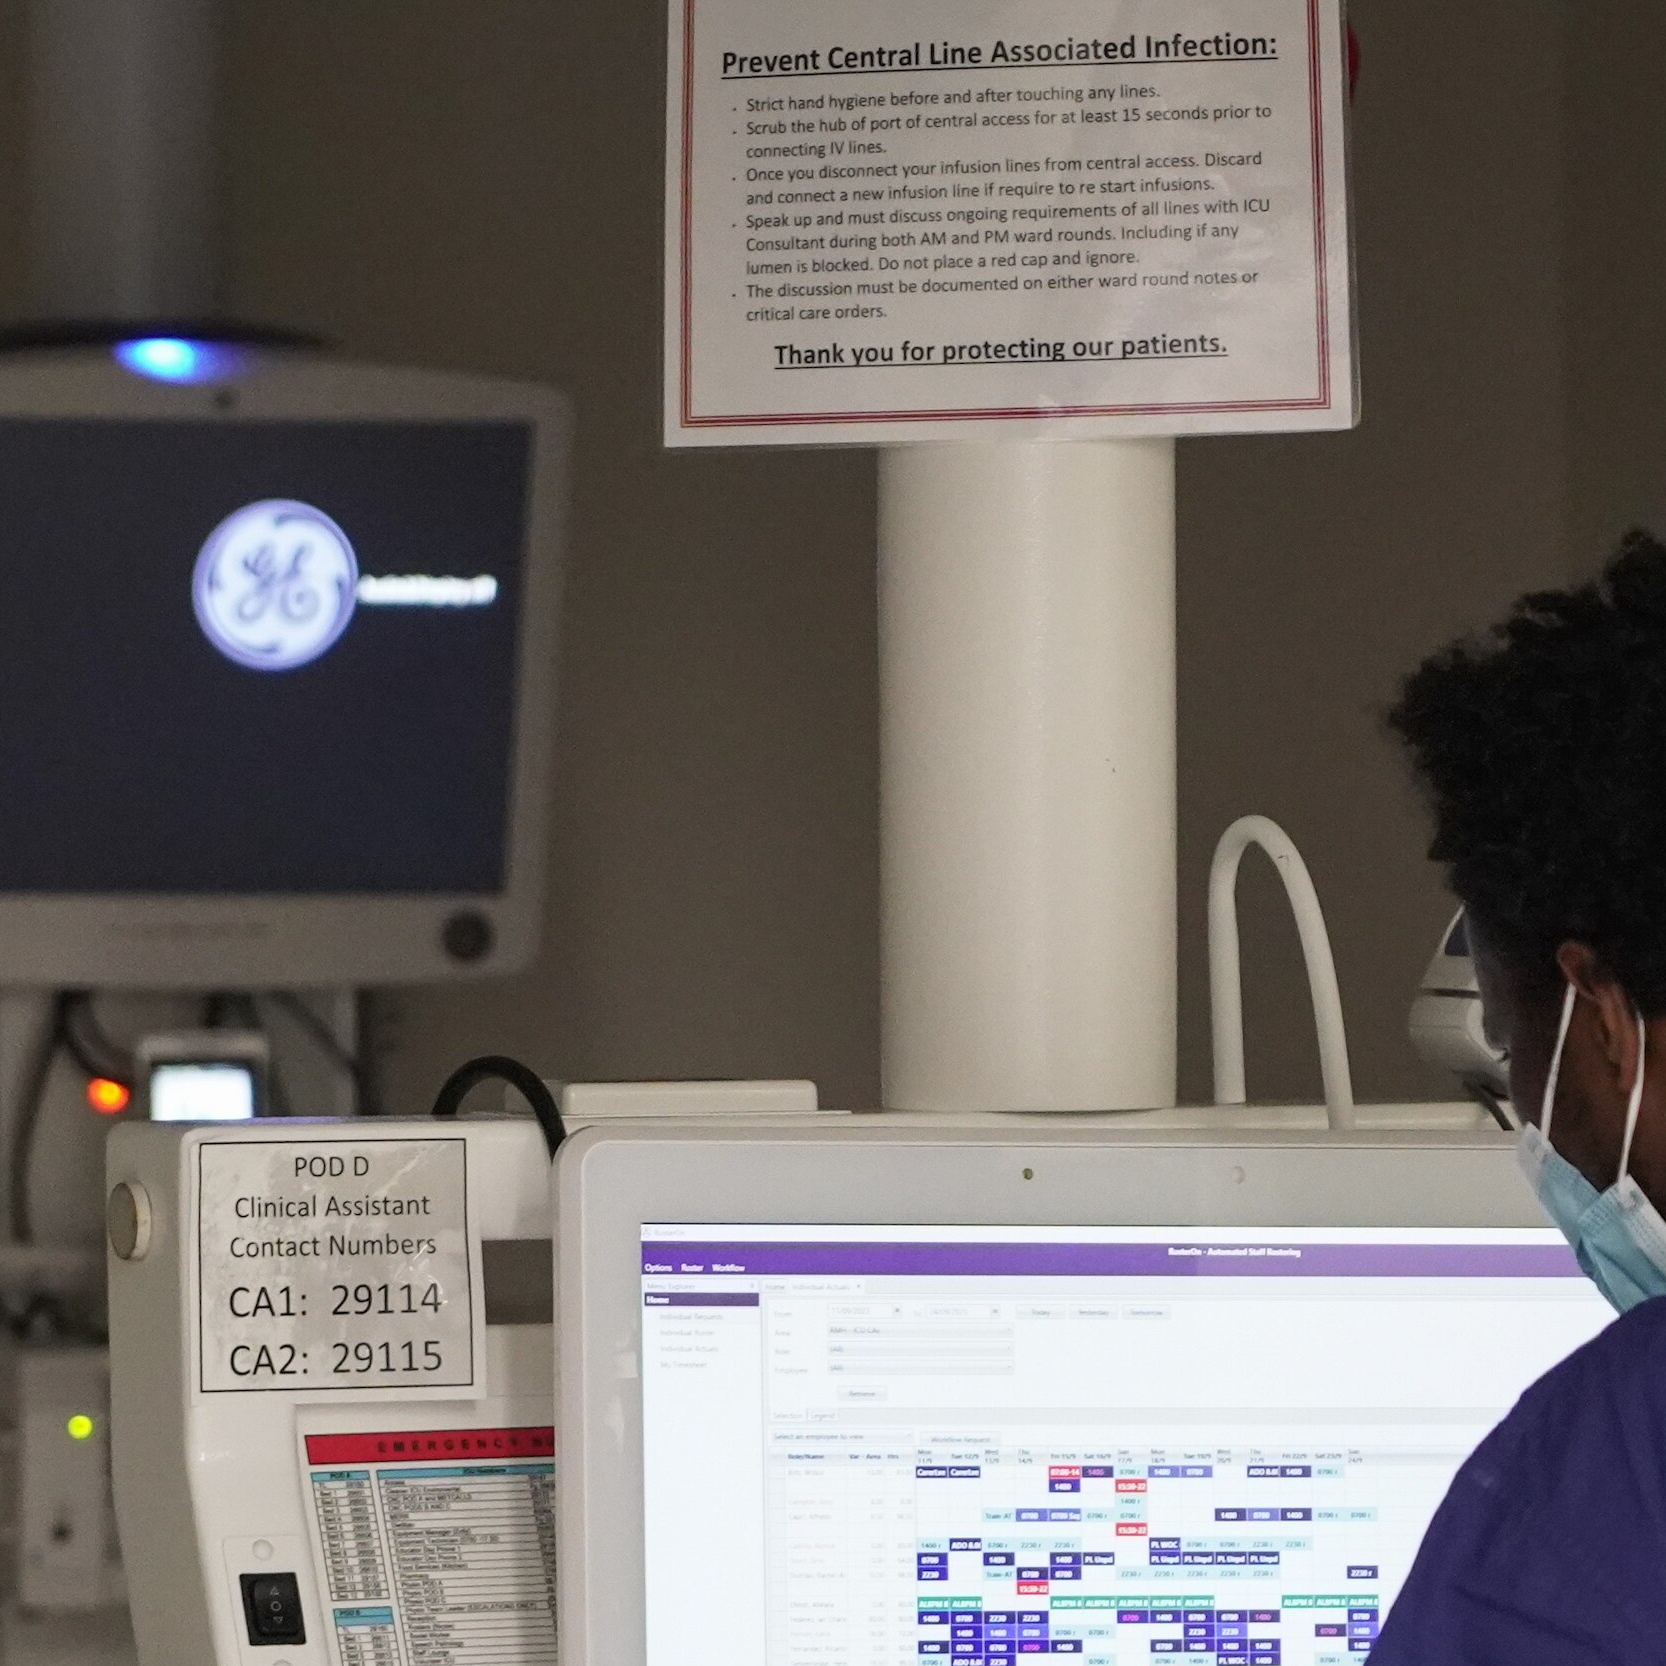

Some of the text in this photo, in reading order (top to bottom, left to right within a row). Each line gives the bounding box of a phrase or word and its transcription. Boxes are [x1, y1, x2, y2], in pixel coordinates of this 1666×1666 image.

[723, 31, 1276, 74] Prevent Central Line Associated Infection:
[746, 84, 1160, 112] Strict hand hygiene before and after touching any lines.
[746, 104, 1272, 135] Scrub the hub of port of central access for at least 15 seconds prior to
[745, 140, 887, 159] connecting IV lines.
[746, 150, 1262, 183] Once you disconnect your infusion lines from central access. Discard
[746, 198, 1270, 231] Speak up and must discuss ongoing requirements of all lines with ICU
[746, 223, 1239, 252] Consultant during both AM and PM ward rounds. Including if any
[745, 270, 1259, 298] The discussion must be documented on either ward round notes or
[746, 303, 887, 322] critical care orders.
[774, 333, 1227, 367] Thank you for protecting our patients.
[295, 1155, 369, 1177] POD D
[235, 1194, 430, 1218] Clinical Assistant
[230, 1232, 436, 1258] Contact Numbers
[644, 1263, 745, 1273] Options Roster Workflow
[229, 1282, 442, 1318] CA1: 29114
[646, 1296, 669, 1304] Home
[230, 1340, 442, 1376] CA2: 29115
